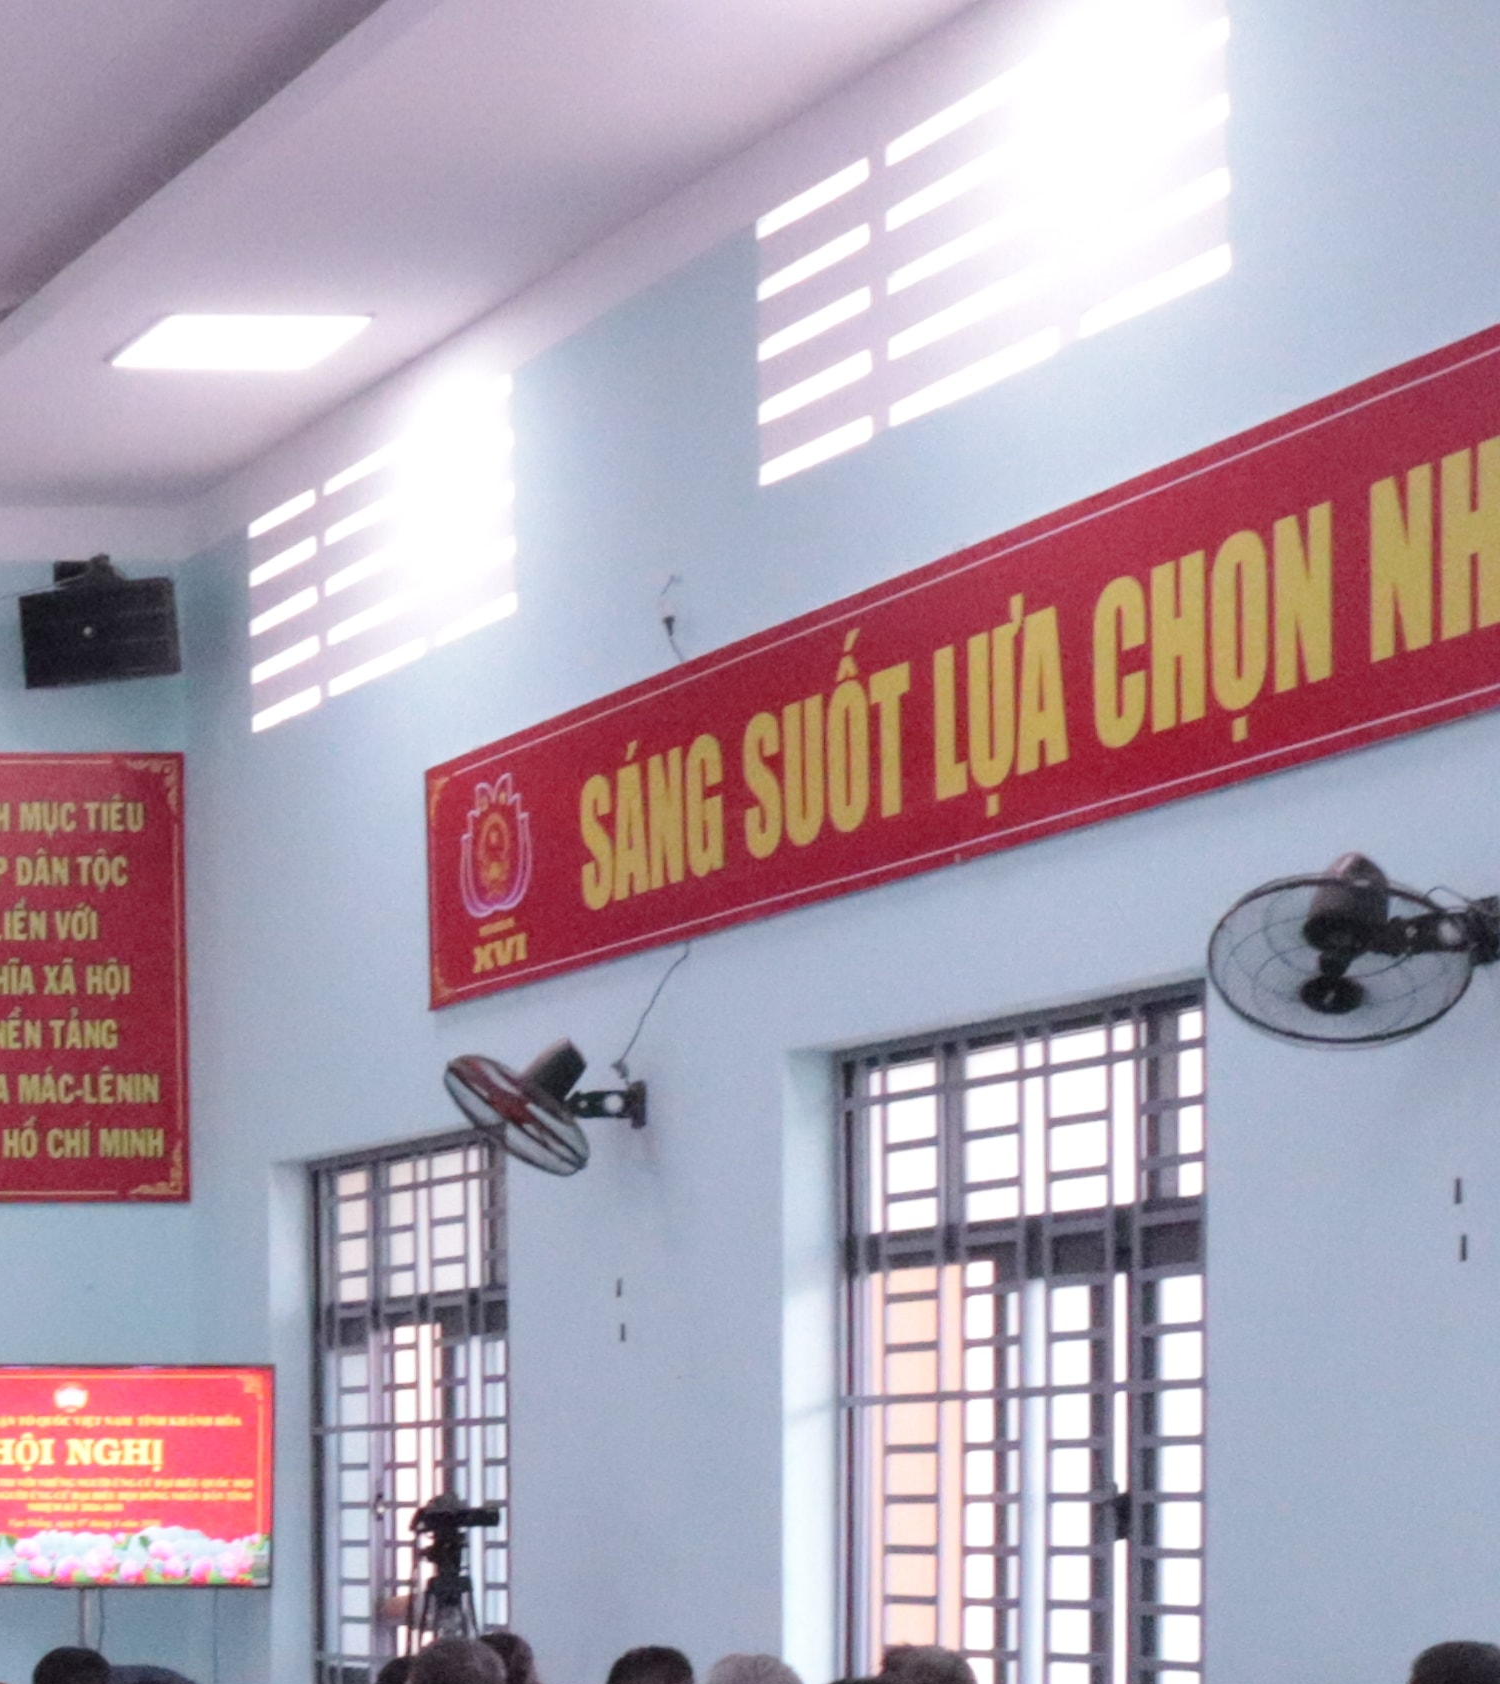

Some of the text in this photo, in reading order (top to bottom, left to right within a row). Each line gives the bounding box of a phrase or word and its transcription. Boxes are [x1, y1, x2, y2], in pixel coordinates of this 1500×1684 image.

[580, 734, 723, 909] SÁNG
[743, 628, 911, 859] SUỐT
[934, 594, 1074, 821] LỰA
[1092, 500, 1333, 744] CHỌN
[19, 802, 76, 835] MỤC
[83, 794, 143, 832] TIÊU
[16, 849, 68, 886] DÂN
[76, 849, 127, 891] TỘC
[54, 907, 97, 940] VỚI
[472, 932, 528, 974] XVI
[44, 958, 76, 995] XÃ
[86, 958, 130, 999] HỘI
[49, 1008, 118, 1049] TẢNG
[46, 1128, 90, 1158] CHÍ
[99, 1129, 164, 1157] MINH
[65, 1438, 164, 1472] NGHỊ
